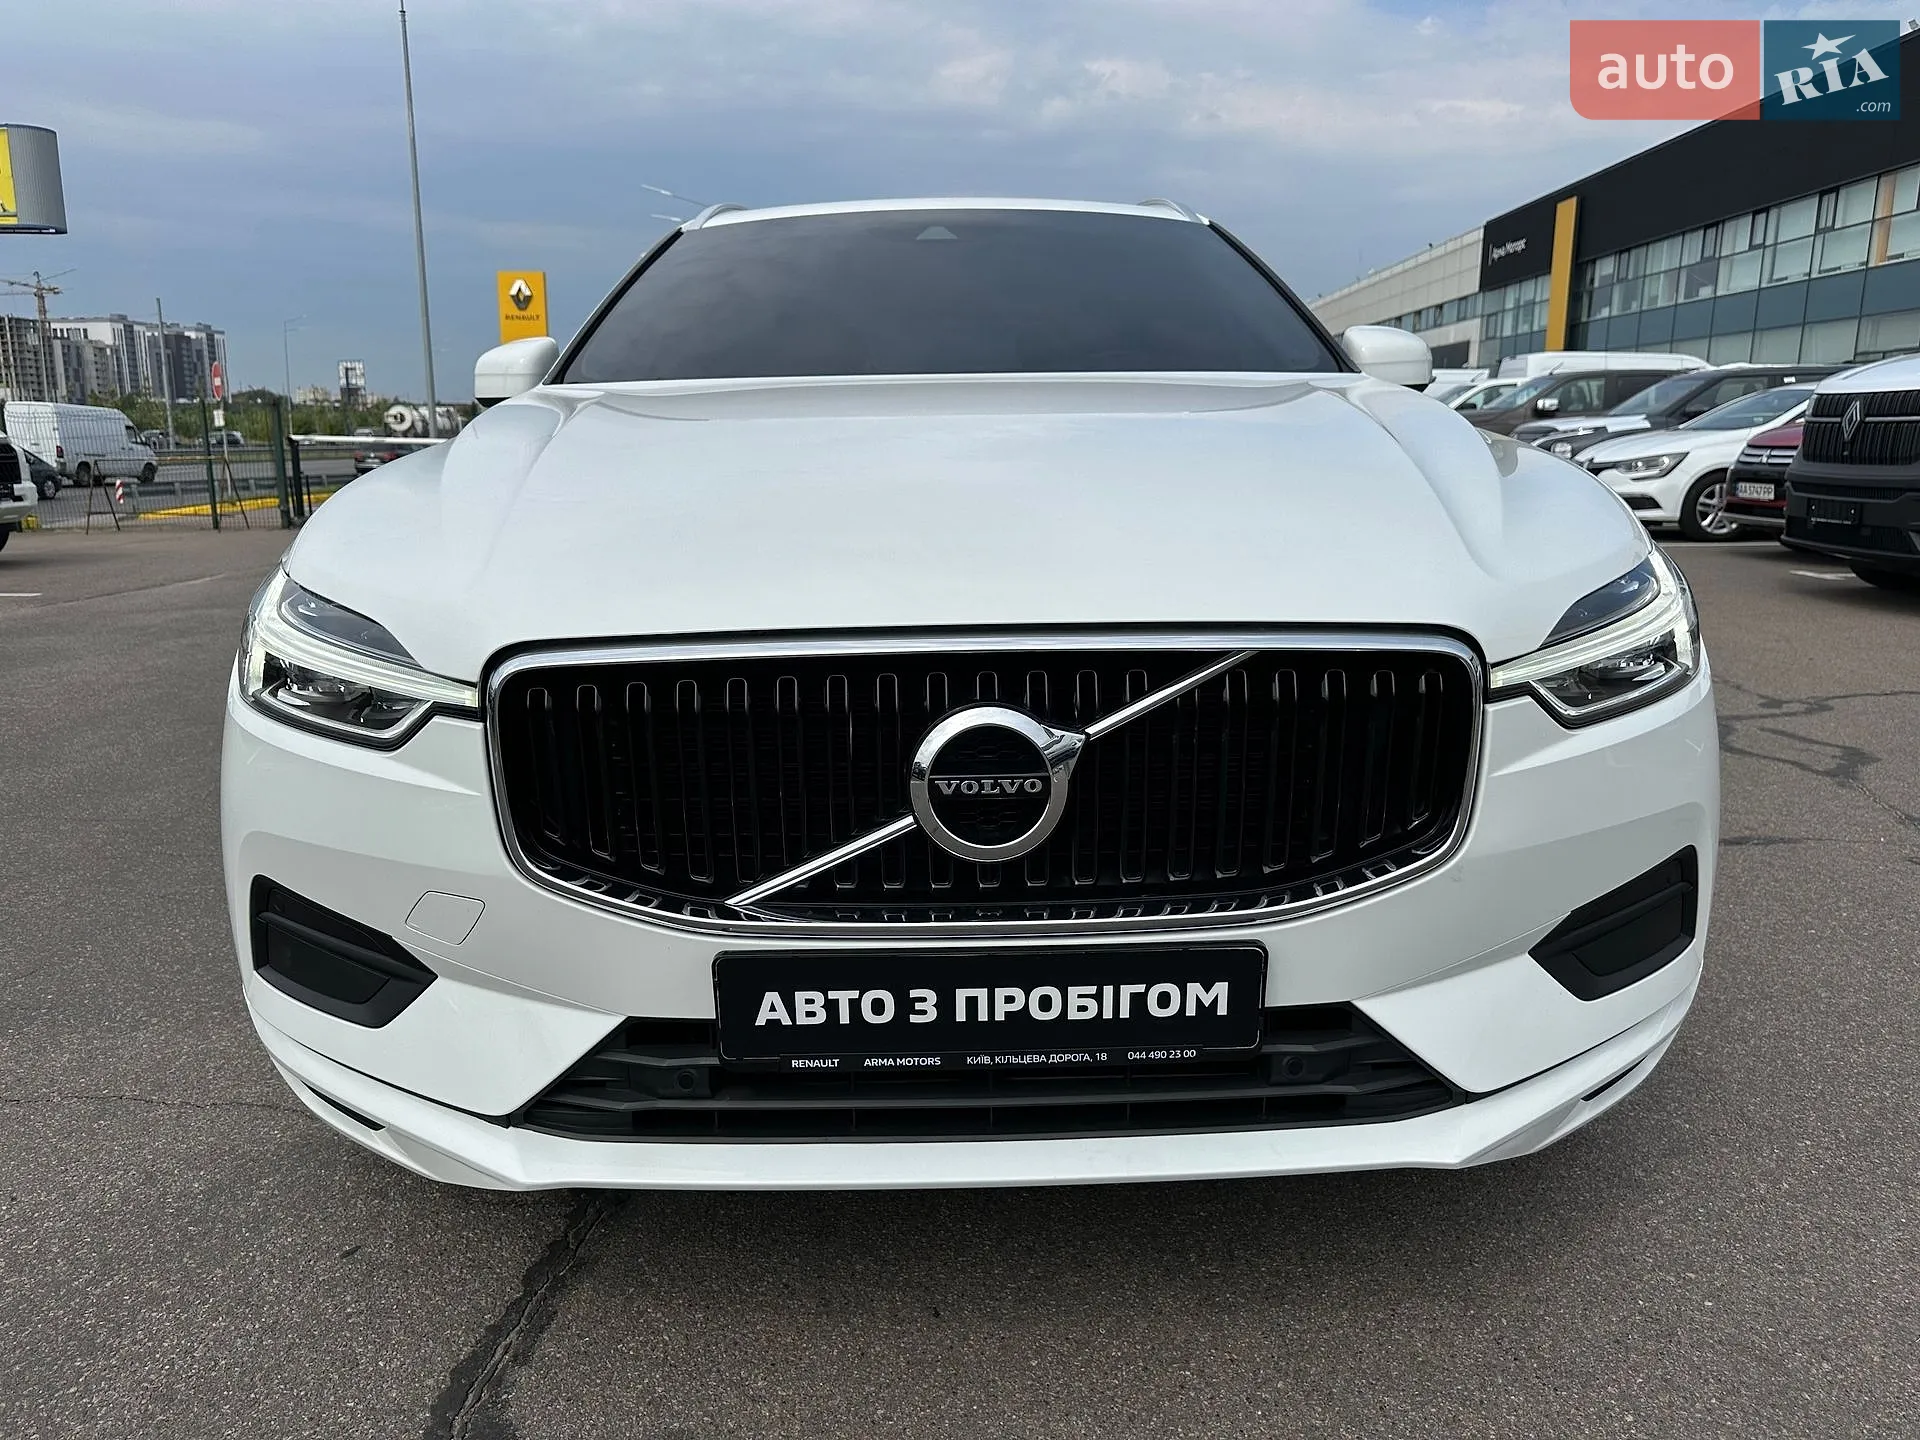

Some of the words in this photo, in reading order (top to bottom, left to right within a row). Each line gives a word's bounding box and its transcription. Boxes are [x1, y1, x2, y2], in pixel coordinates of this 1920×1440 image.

[934, 778, 1043, 795] VOLVO
[755, 989, 895, 1026] АВТО
[955, 981, 1229, 1022] ПРОБІГОМ
[863, 1058, 895, 1067] ARMA
[896, 1056, 941, 1067] MOTORS
[966, 1055, 993, 1066] КИЇВ,
[994, 1054, 1047, 1065] КІЛЬЦЕВА
[1048, 1053, 1093, 1064] ДОРОГА,
[1095, 1052, 1108, 1062] 18
[1127, 1051, 1147, 1061] 044
[1148, 1050, 1167, 1060] 490
[1168, 1050, 1182, 1059] 23
[1183, 1049, 1197, 1058] 00
[791, 1058, 840, 1068] RENAULT
